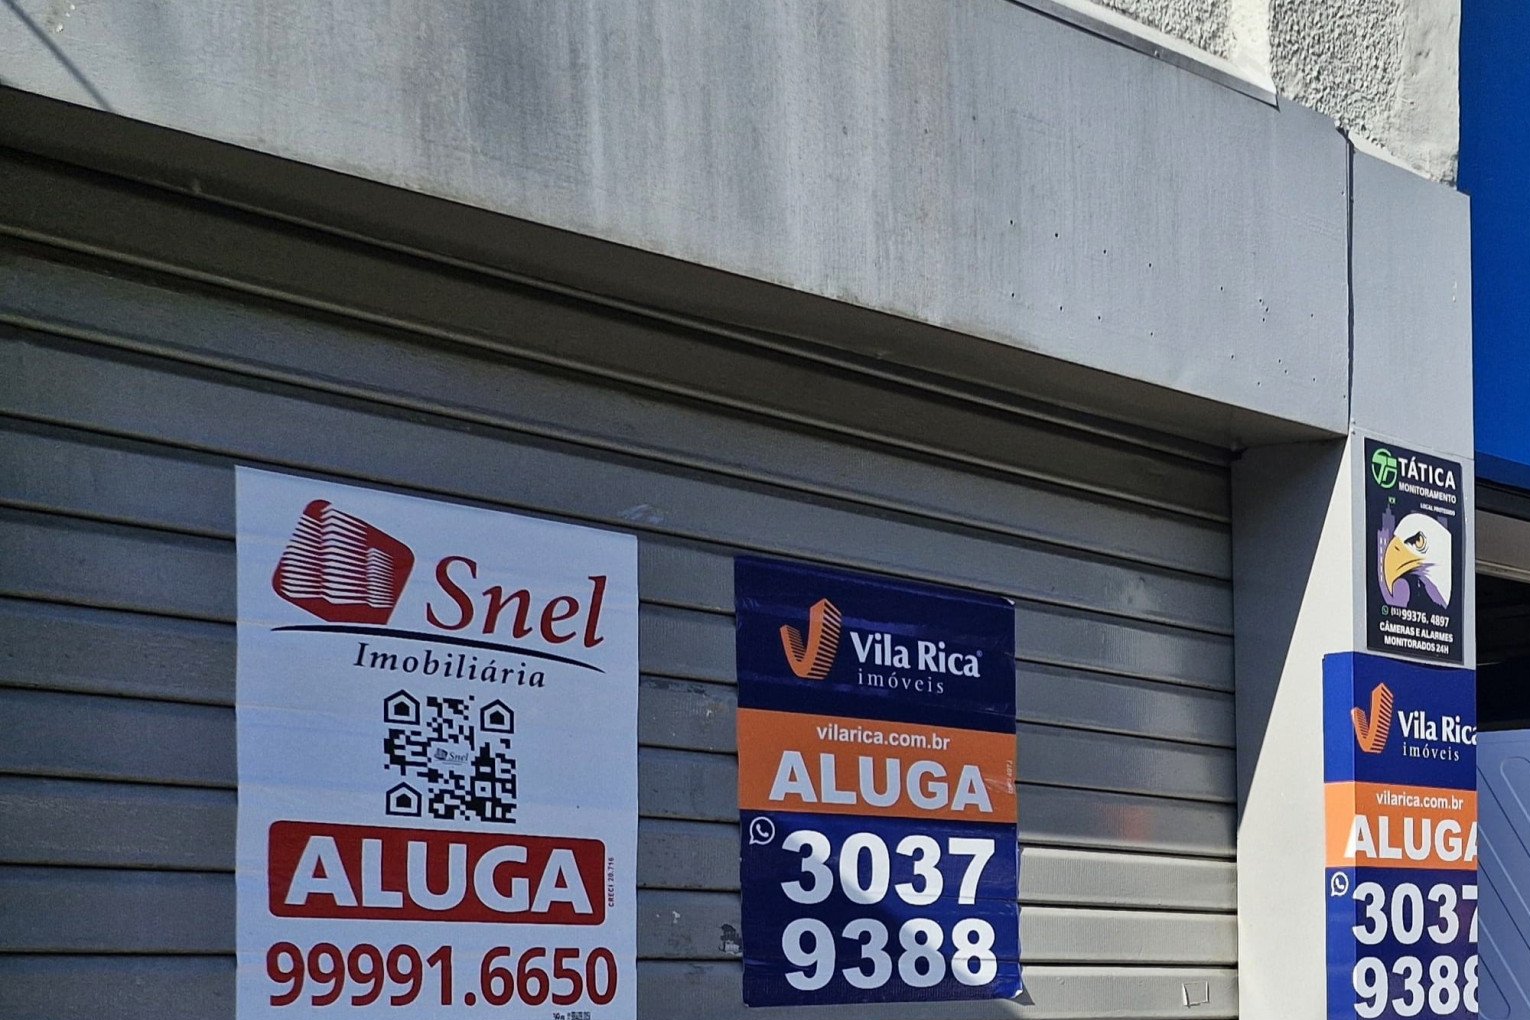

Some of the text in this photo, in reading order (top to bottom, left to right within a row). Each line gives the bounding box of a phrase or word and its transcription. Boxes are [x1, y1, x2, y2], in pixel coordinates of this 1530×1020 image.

[1398, 456, 1456, 490] TÁTICA
[1398, 482, 1457, 504] MONITORAMENTO
[425, 555, 606, 648] Snel
[1430, 614, 1450, 628] 4897
[1380, 620, 1453, 642] CÂMERAS E ALARMES
[1384, 636, 1449, 654] MONITORADOS 24H
[353, 642, 546, 688] Imobiliária
[850, 631, 981, 678] Vila Rica
[858, 670, 945, 694] imóveis
[817, 725, 950, 751] vilarica.com.br
[1398, 710, 1438, 742] Vila
[1403, 743, 1460, 762] imóveis
[769, 750, 993, 813] ALUGA
[1376, 791, 1464, 811] vilarica.com.br
[1344, 814, 1478, 863] ALUGA
[284, 836, 593, 915] ALUGA
[780, 830, 996, 906] 3037
[1352, 881, 1478, 945] 3037
[268, 941, 618, 1007] 99991.6650
[781, 918, 998, 991] 9388
[1352, 954, 1478, 1019] 9388
